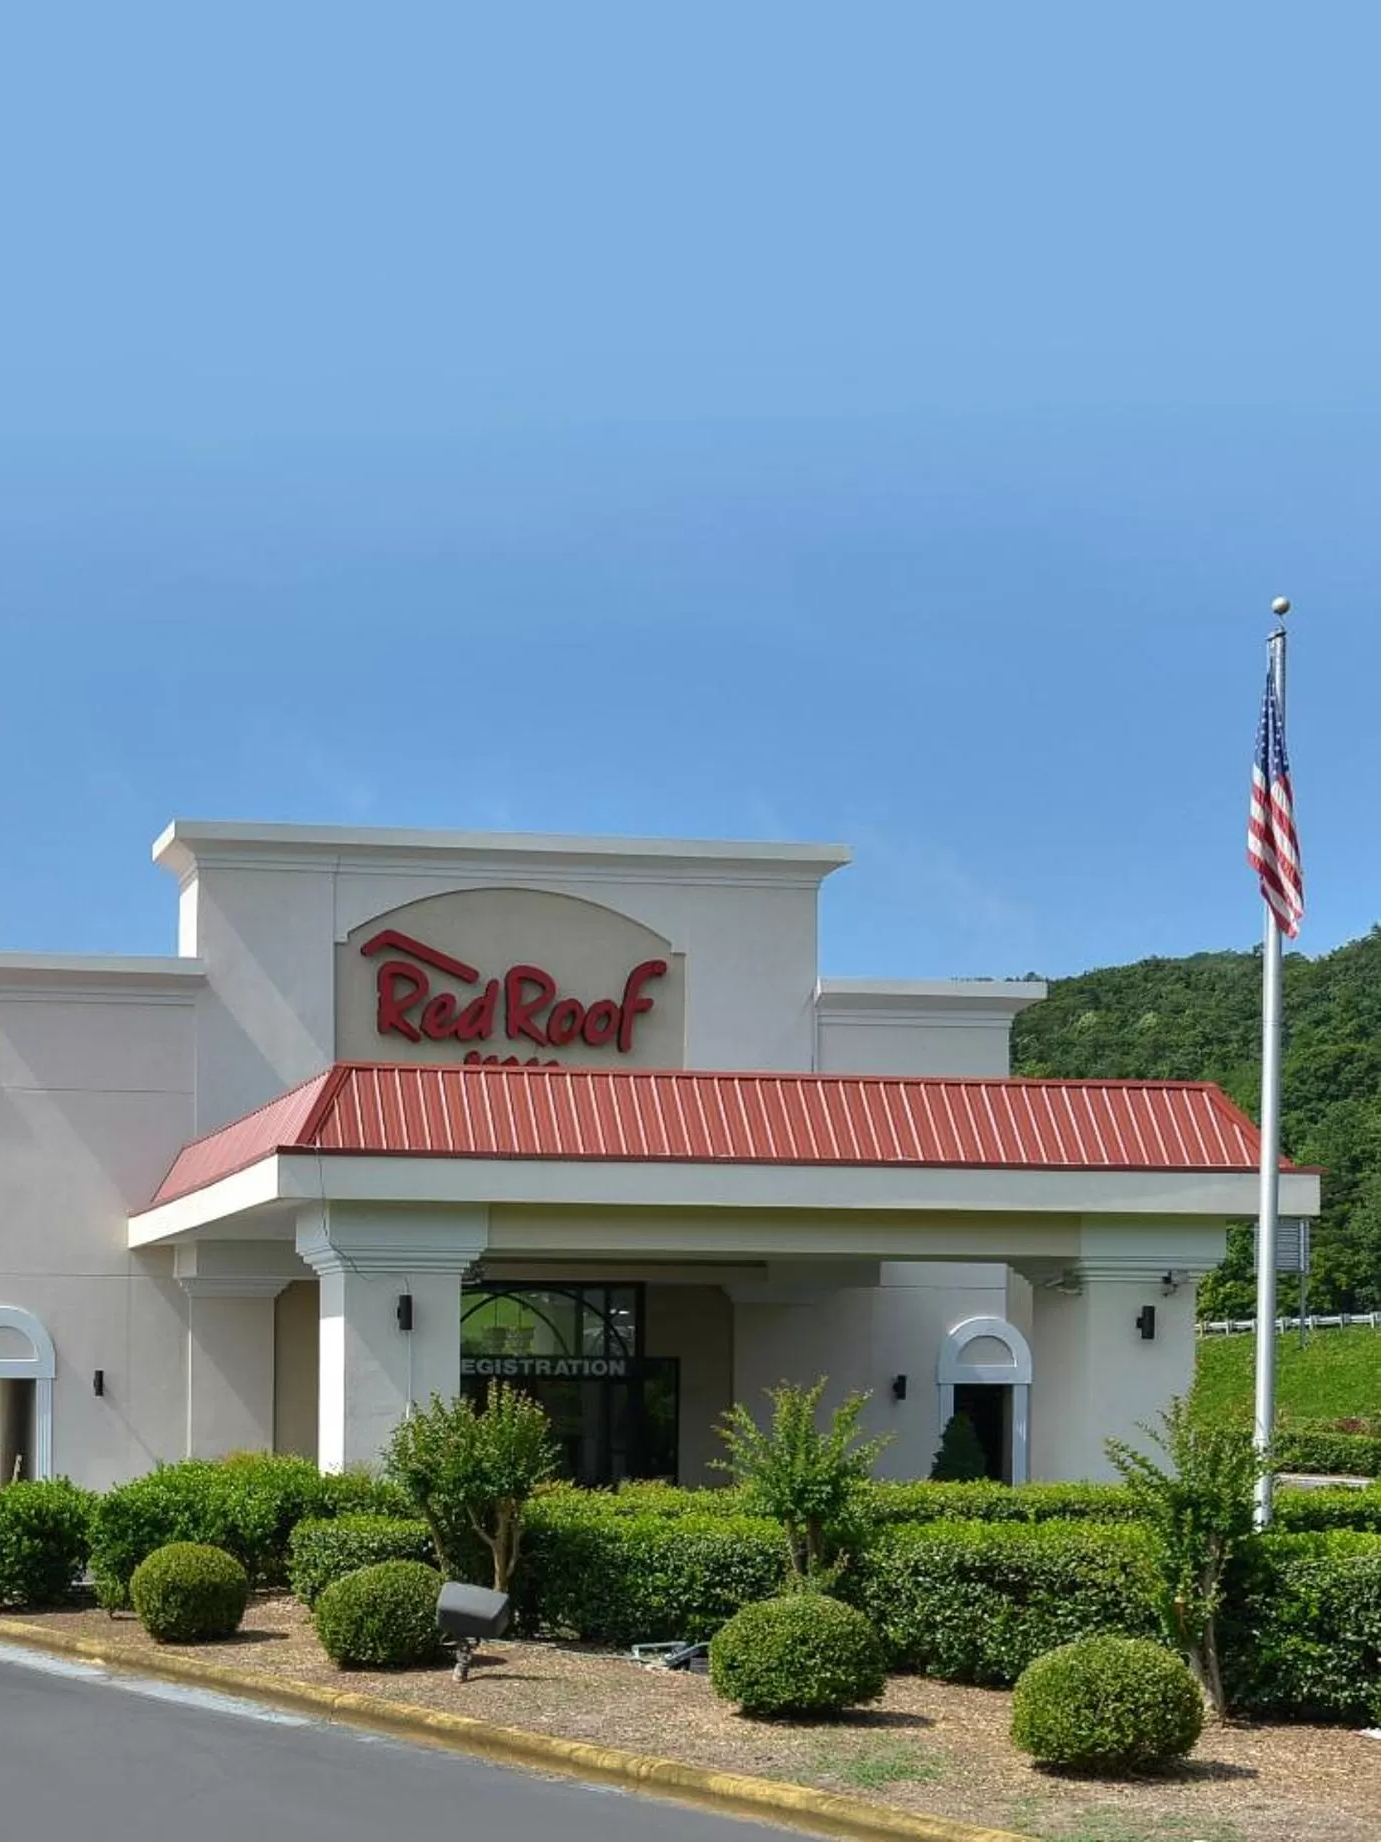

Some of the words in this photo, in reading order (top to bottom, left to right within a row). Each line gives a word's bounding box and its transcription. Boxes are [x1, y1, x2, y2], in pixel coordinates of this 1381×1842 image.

[376, 960, 500, 1043] Red
[504, 959, 668, 1053] Roof
[461, 1358, 626, 1376] EGISTRATION
